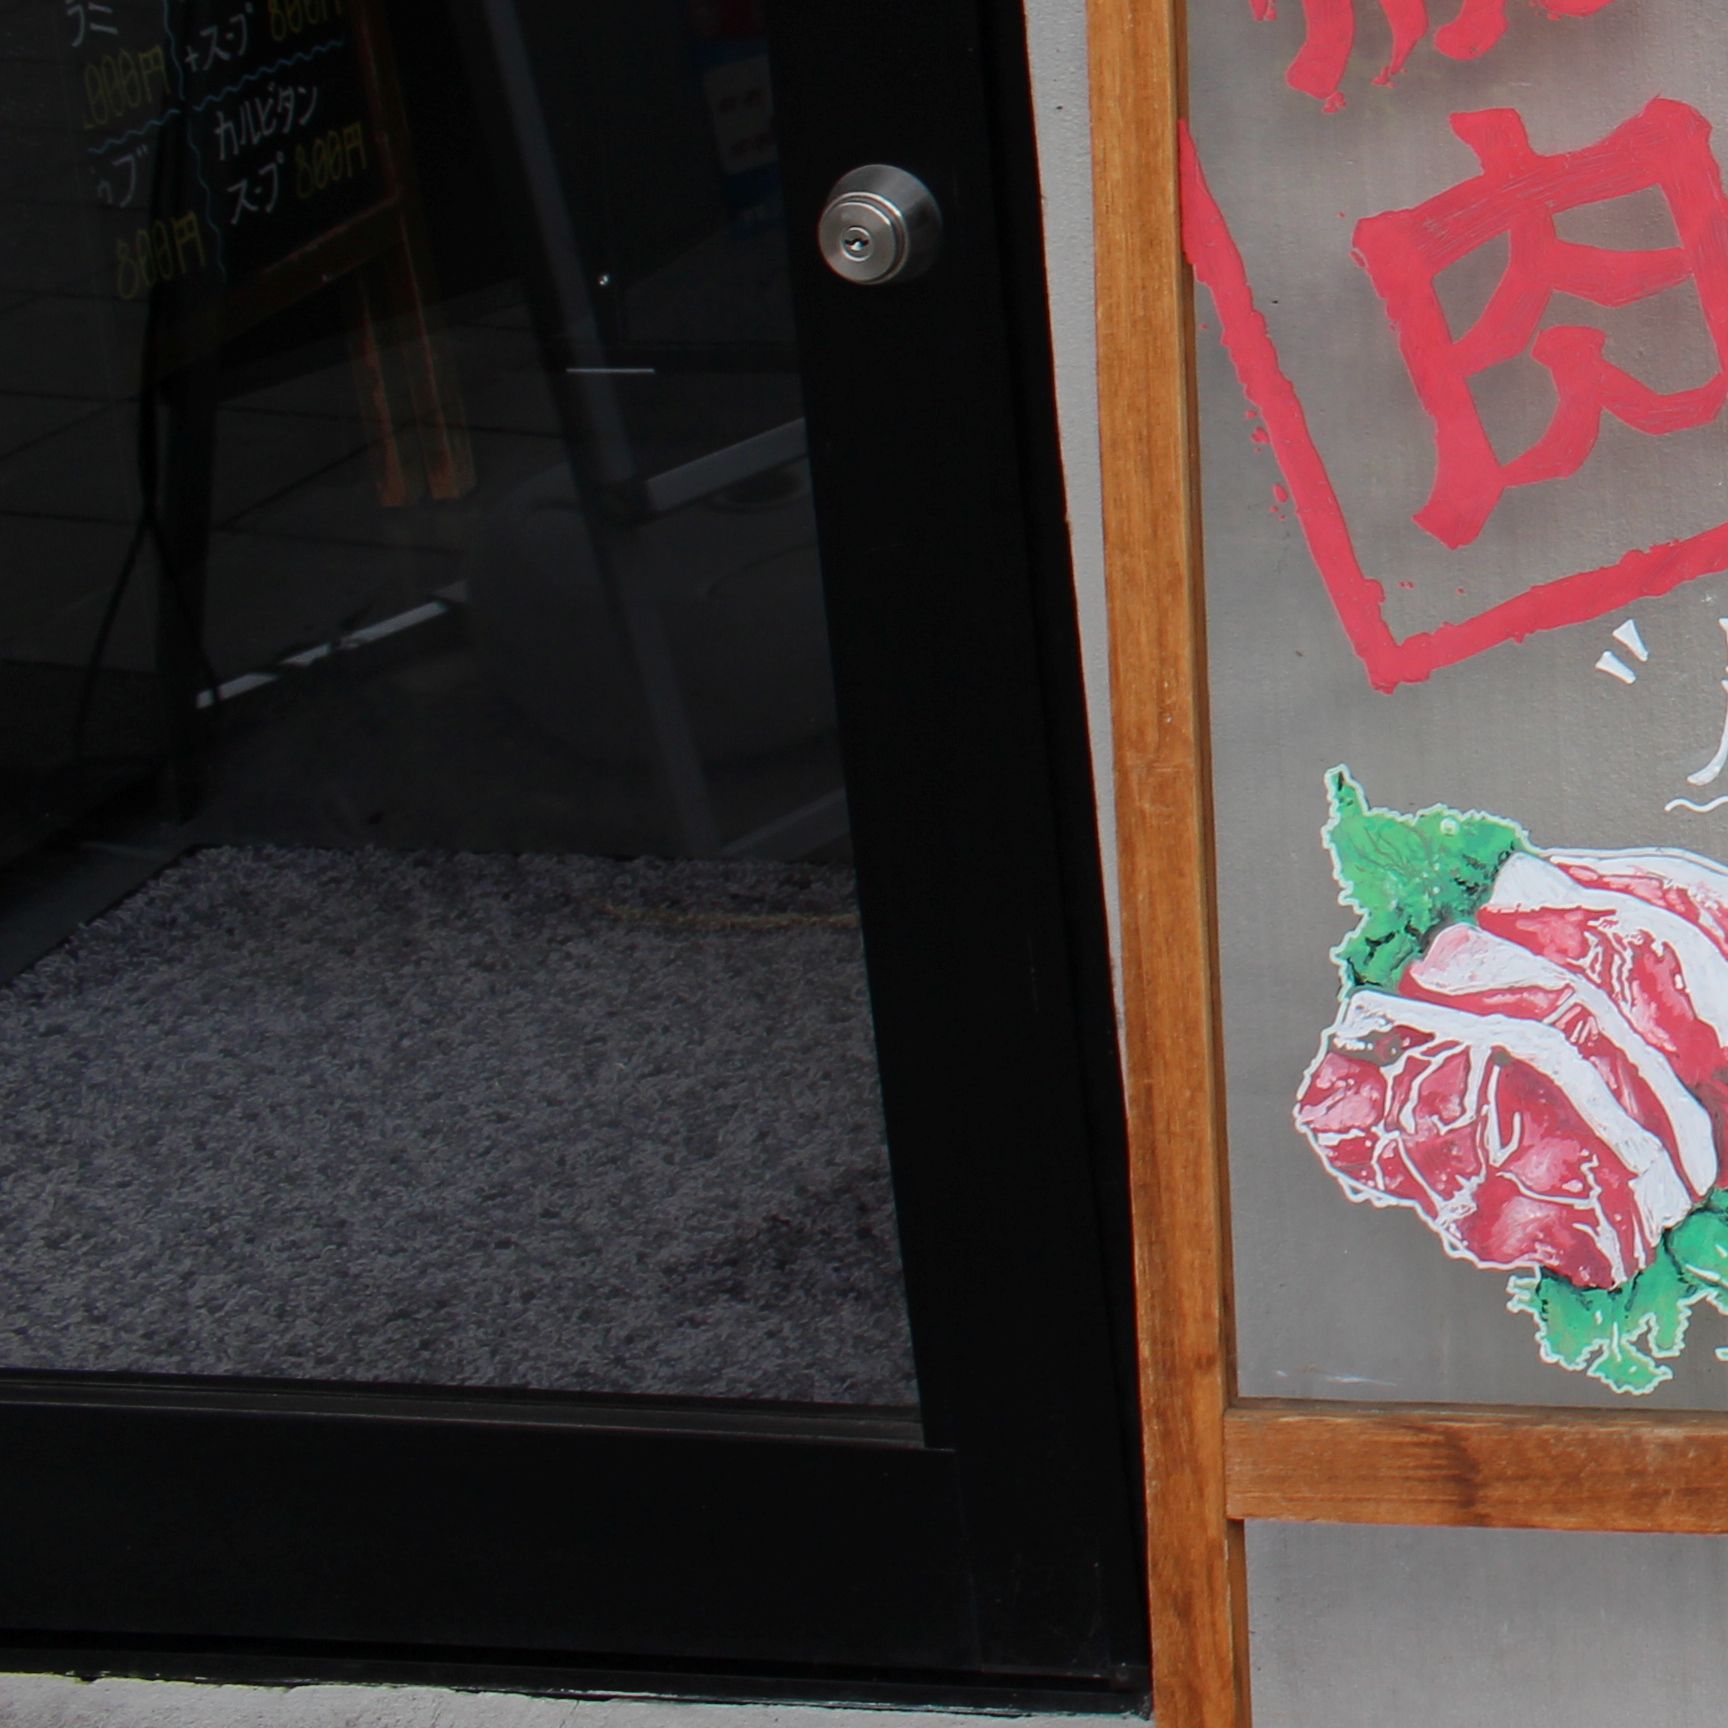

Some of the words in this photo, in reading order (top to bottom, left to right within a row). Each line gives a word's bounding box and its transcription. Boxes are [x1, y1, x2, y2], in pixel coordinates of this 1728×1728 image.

[214, 83, 319, 161] カルビタン
